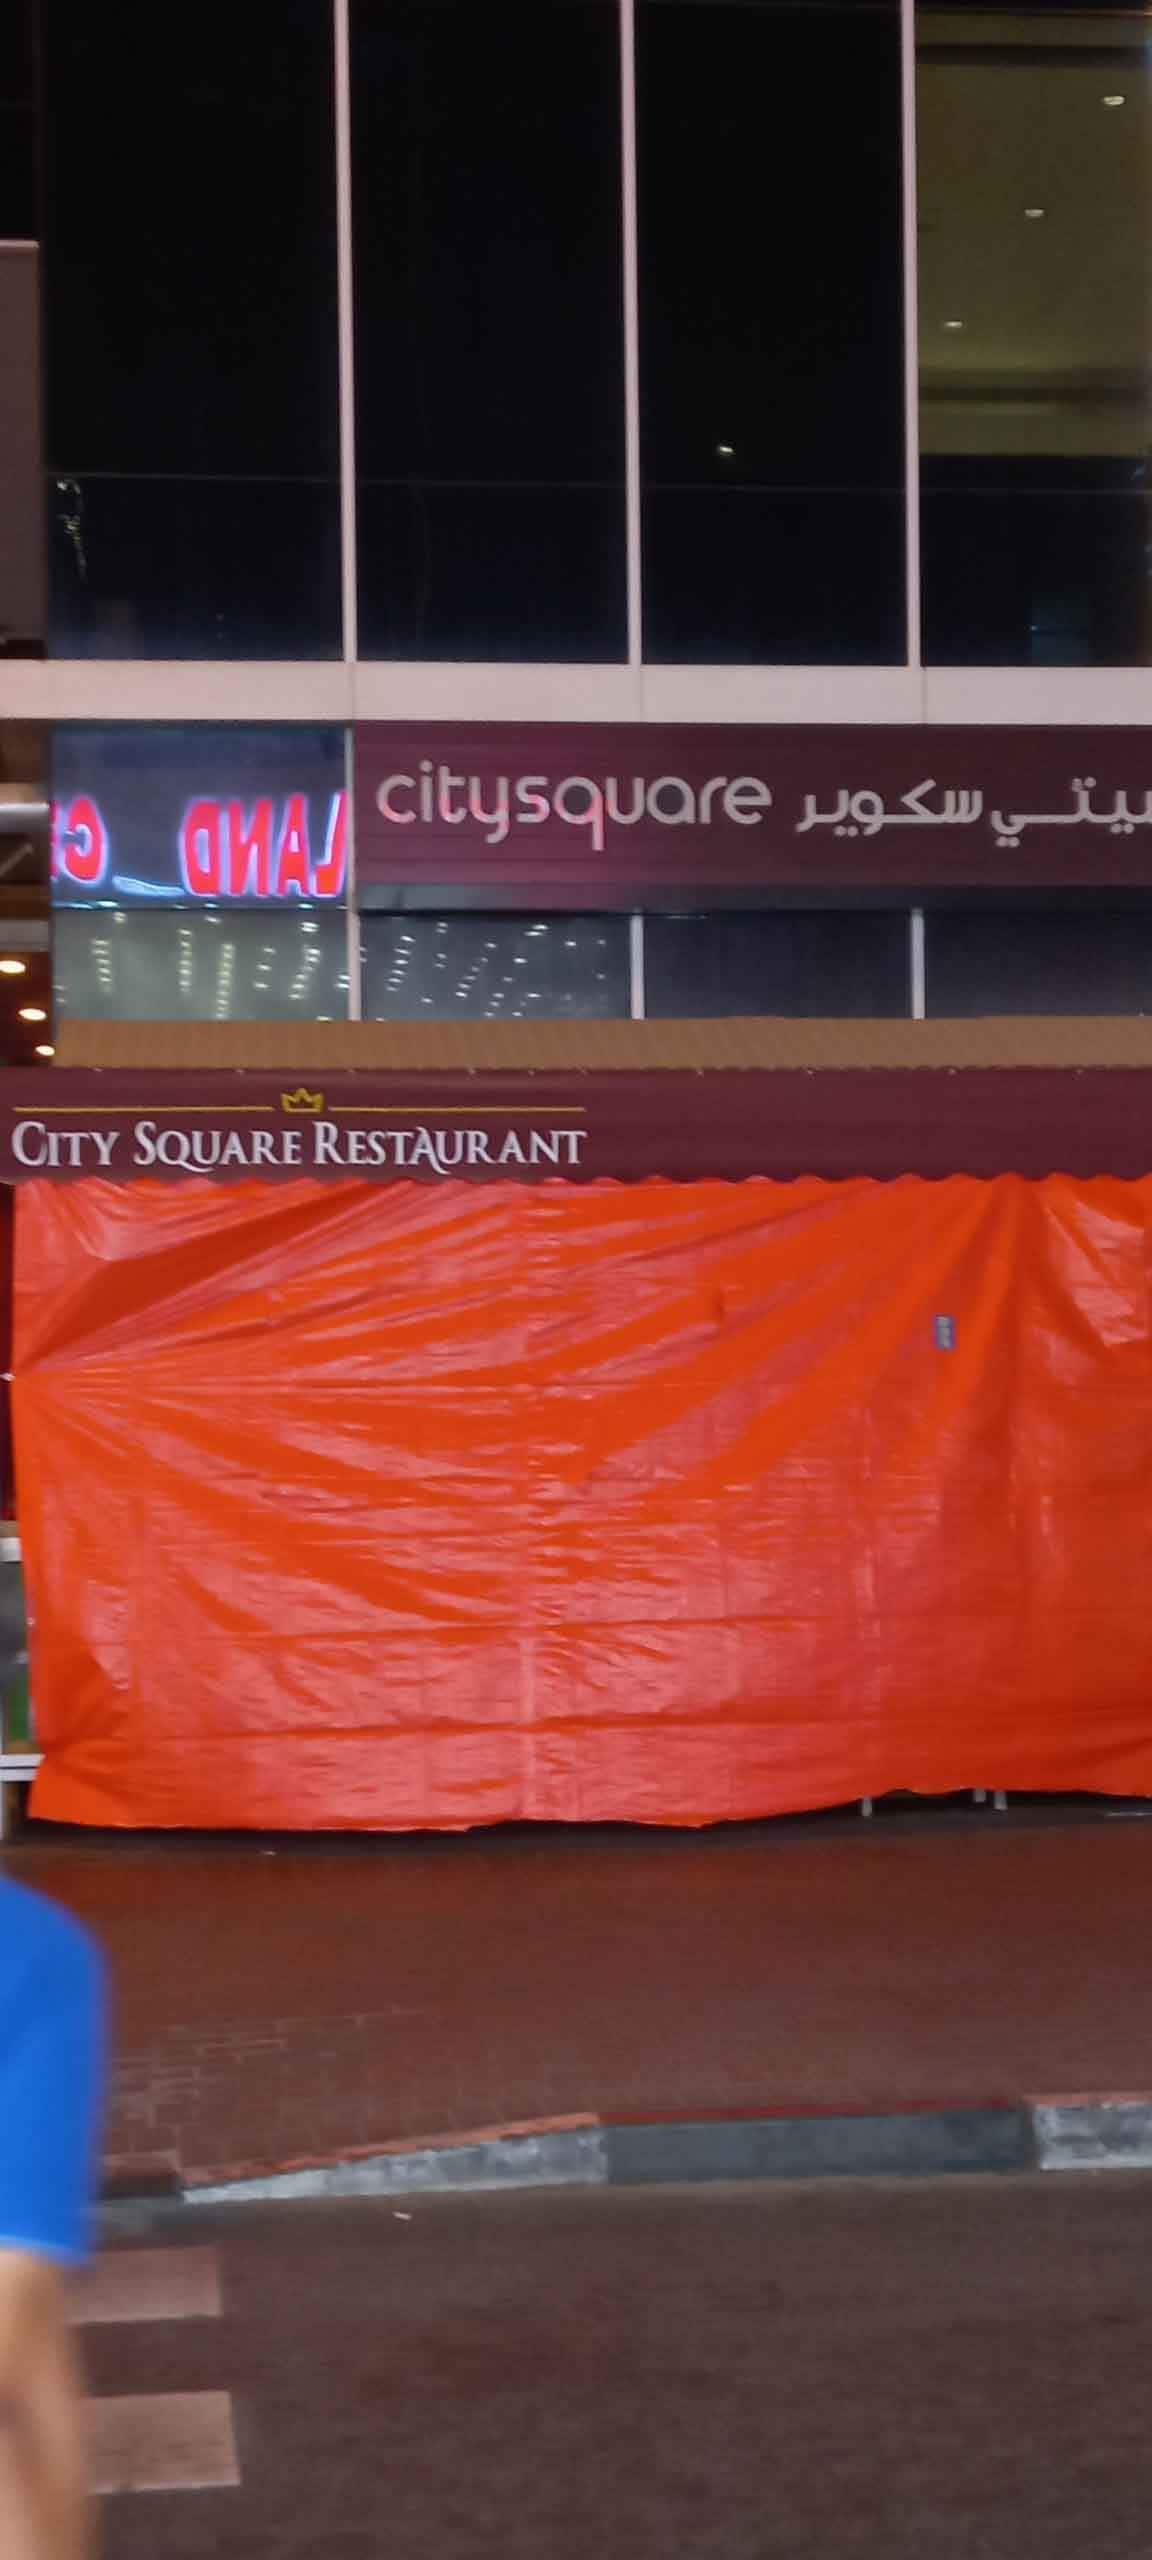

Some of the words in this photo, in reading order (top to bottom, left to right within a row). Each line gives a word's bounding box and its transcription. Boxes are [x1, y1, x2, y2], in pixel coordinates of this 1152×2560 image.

[376, 761, 772, 850] citysquare
[795, 779, 984, 837] سكوير
[11, 1119, 119, 1166] CITY
[133, 1119, 302, 1172] SQUARE
[312, 1119, 588, 1175] RESTAURANT
